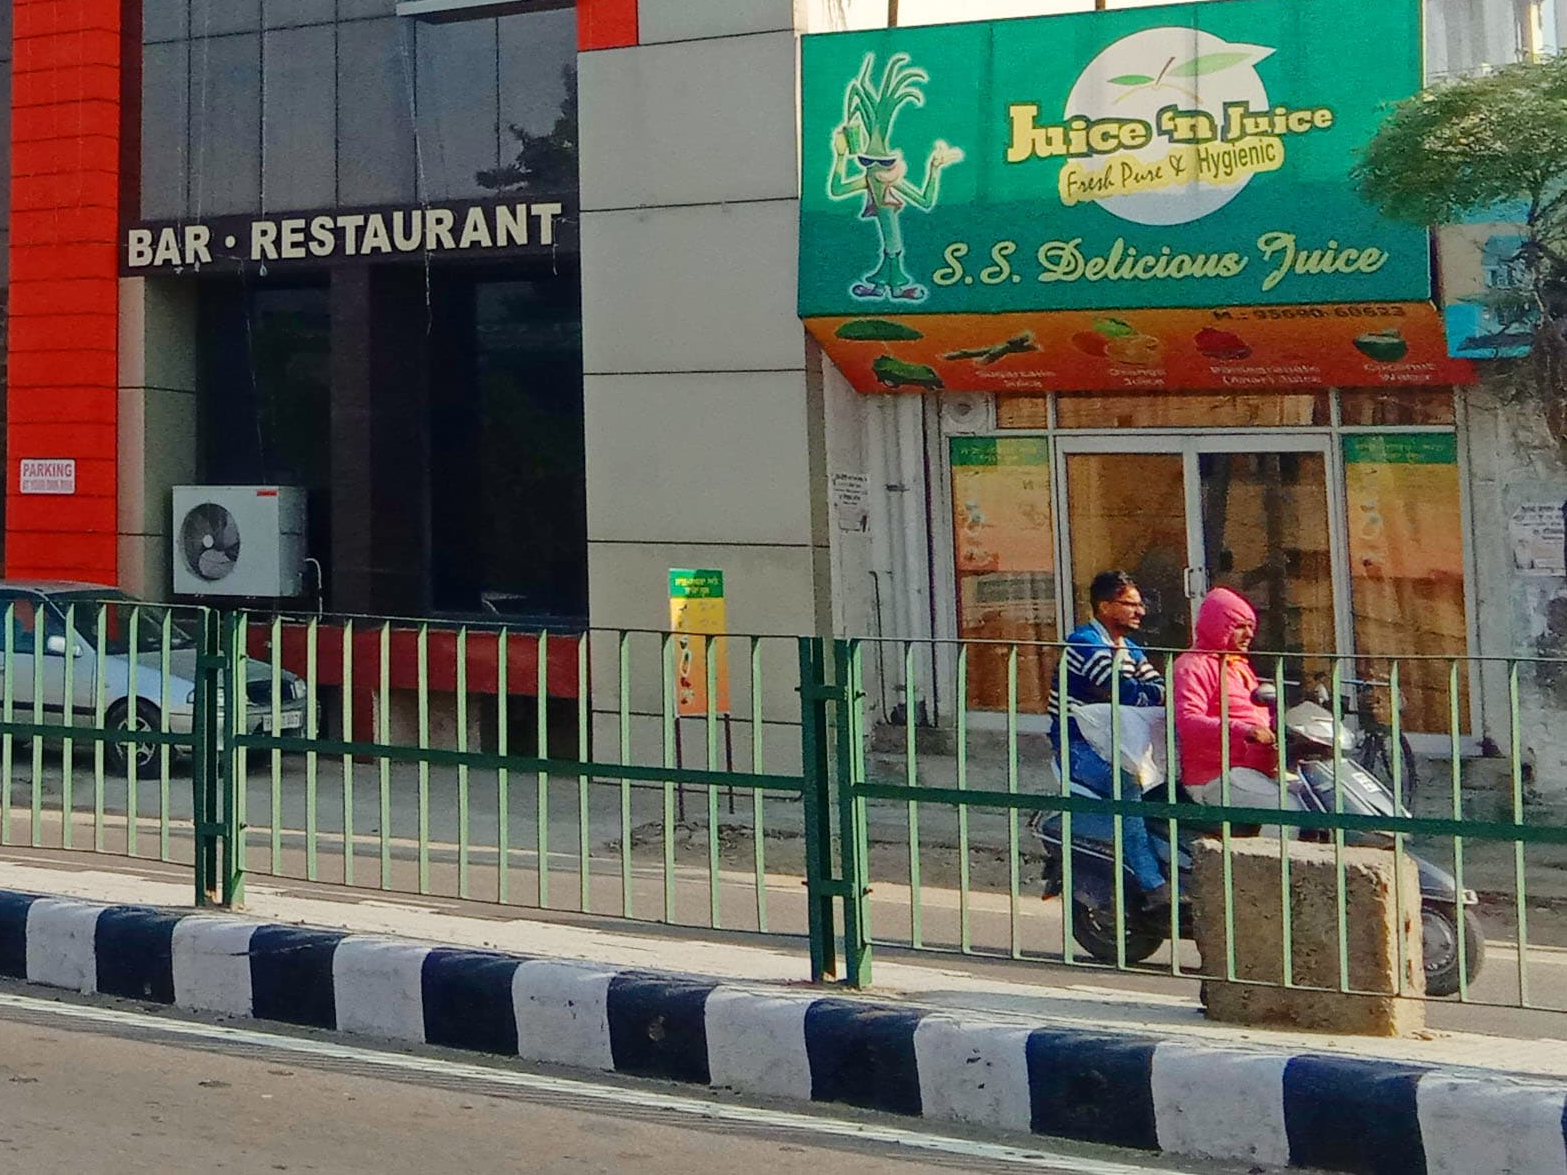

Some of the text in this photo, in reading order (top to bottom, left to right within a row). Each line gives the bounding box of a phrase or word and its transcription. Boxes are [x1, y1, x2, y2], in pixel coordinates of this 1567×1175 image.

[1007, 104, 1148, 162] Juice
[1226, 107, 1333, 139] Juice
[1066, 165, 1116, 198] Fresh
[1121, 161, 1163, 189] Pure
[1195, 140, 1277, 179] Hygienic
[128, 202, 563, 267] BAR RESTAURANT
[933, 231, 1390, 292] S.S. Delicious Juice
[22, 463, 73, 477] PARKING
